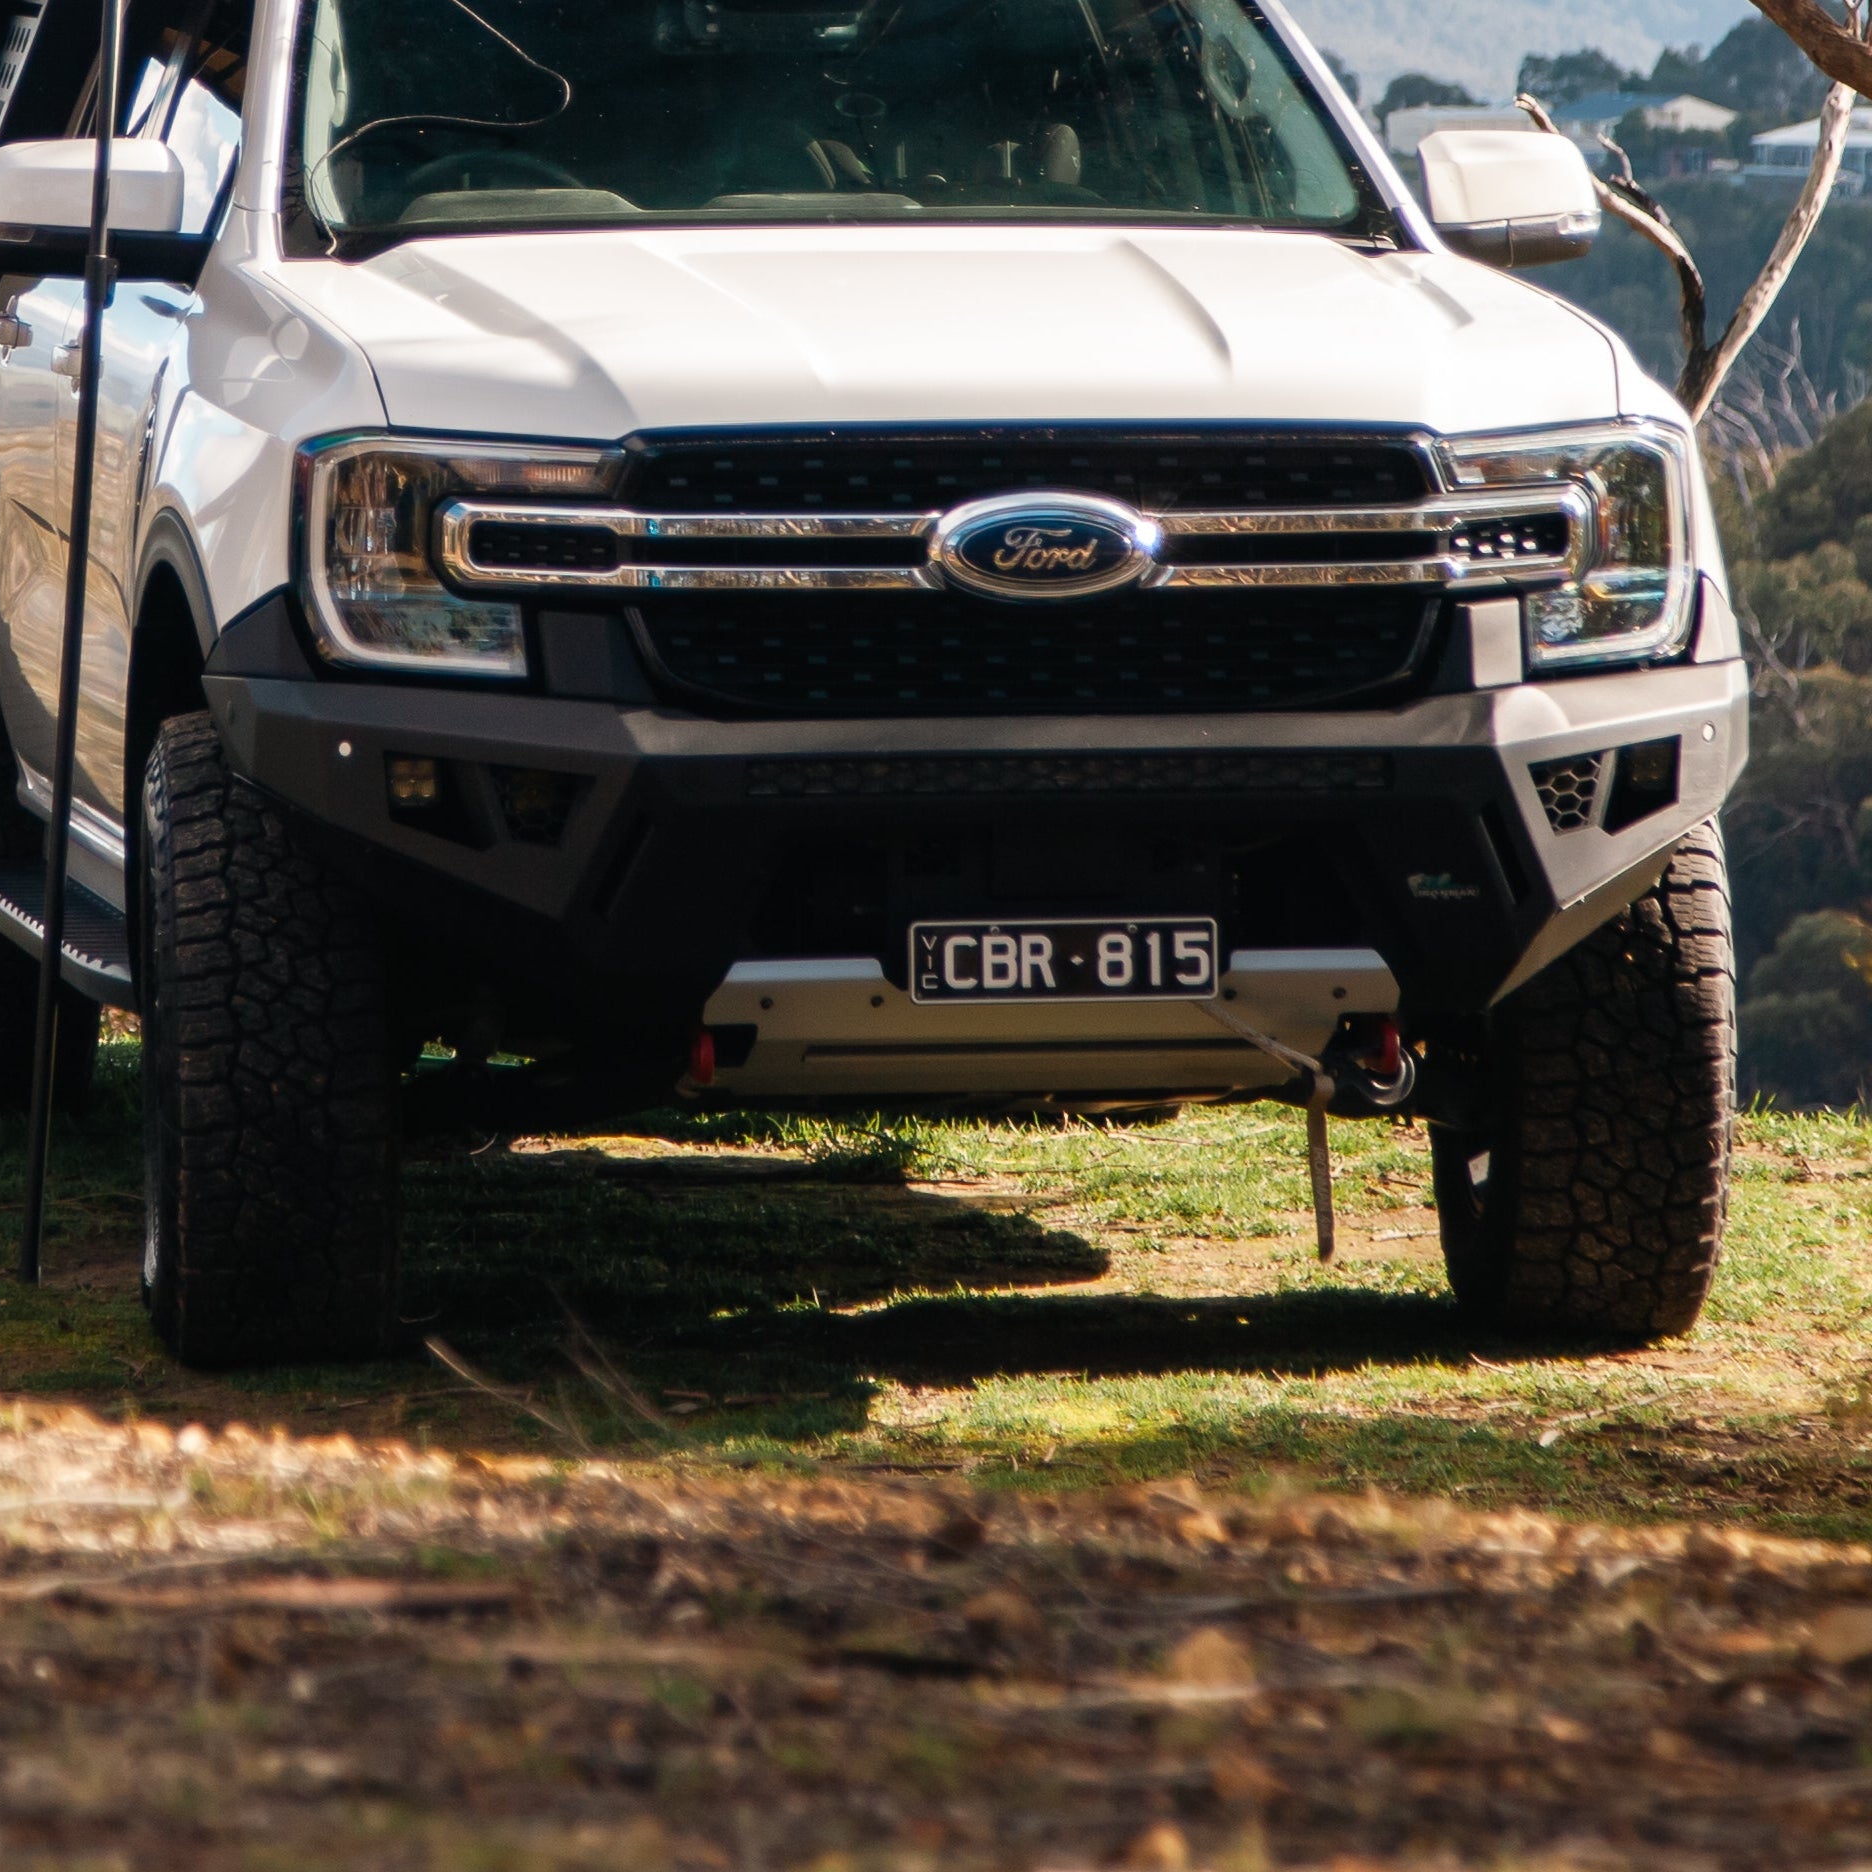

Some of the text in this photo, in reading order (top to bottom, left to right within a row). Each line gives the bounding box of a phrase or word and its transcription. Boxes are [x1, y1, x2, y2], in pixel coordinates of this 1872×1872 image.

[994, 527, 1098, 570] Ford
[921, 934, 939, 990] VIC
[944, 931, 1210, 990] CBR 815
